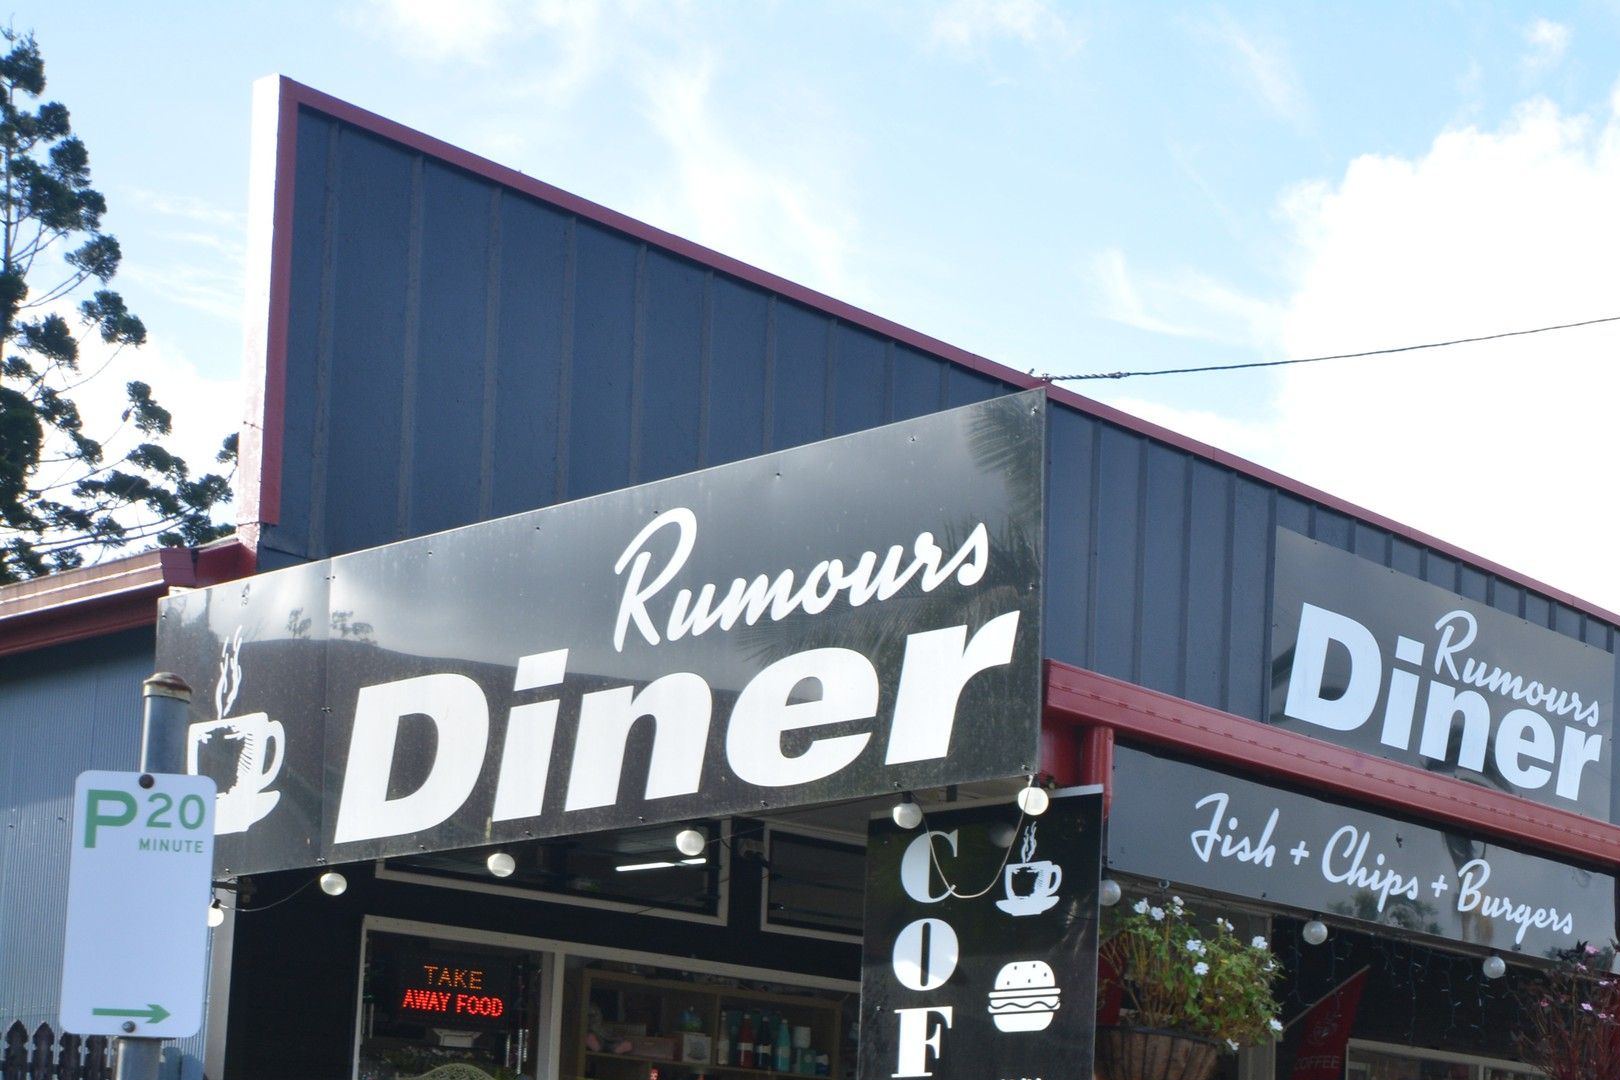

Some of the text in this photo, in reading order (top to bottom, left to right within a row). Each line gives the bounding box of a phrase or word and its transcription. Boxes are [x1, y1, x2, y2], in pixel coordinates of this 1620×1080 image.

[614, 507, 989, 652] Rumours
[334, 610, 1020, 844] Diner
[1284, 602, 1603, 801] Diner
[1434, 609, 1600, 727] Rumours
[83, 789, 206, 848] P 20
[138, 838, 204, 853] MINUTE
[1190, 792, 1279, 868] Fish
[1321, 825, 1419, 913] Chips
[1456, 858, 1574, 944] Burgers
[402, 988, 503, 1017] AWAY FOOD
[424, 965, 483, 990] TAKE
